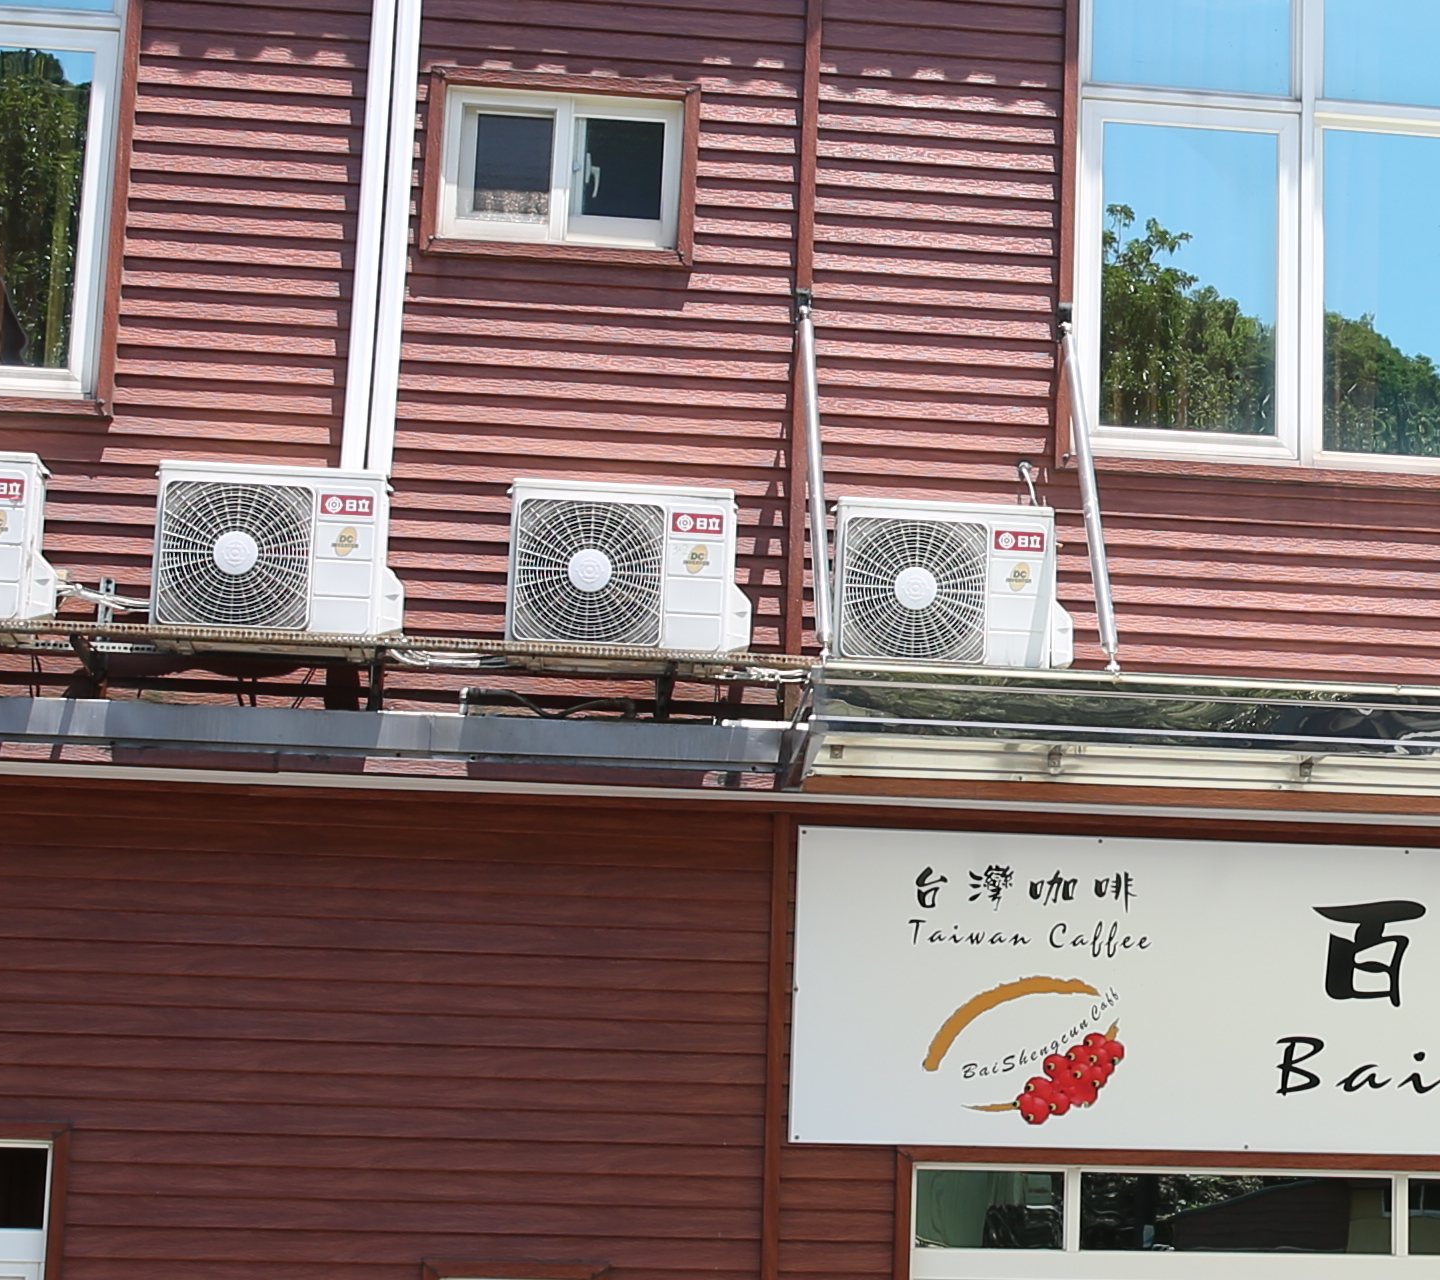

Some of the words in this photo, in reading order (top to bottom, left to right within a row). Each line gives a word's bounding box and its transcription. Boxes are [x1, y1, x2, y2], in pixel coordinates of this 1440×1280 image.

[345, 499, 370, 512] 日立
[696, 518, 720, 530] 日立
[1017, 535, 1040, 548] 日立
[1013, 570, 1026, 578] DC
[916, 864, 1138, 913] 台灣咖啡
[908, 919, 1032, 946] Taiwan
[1049, 921, 1152, 958] Caffee
[962, 1019, 1089, 1079] BaiShengcun
